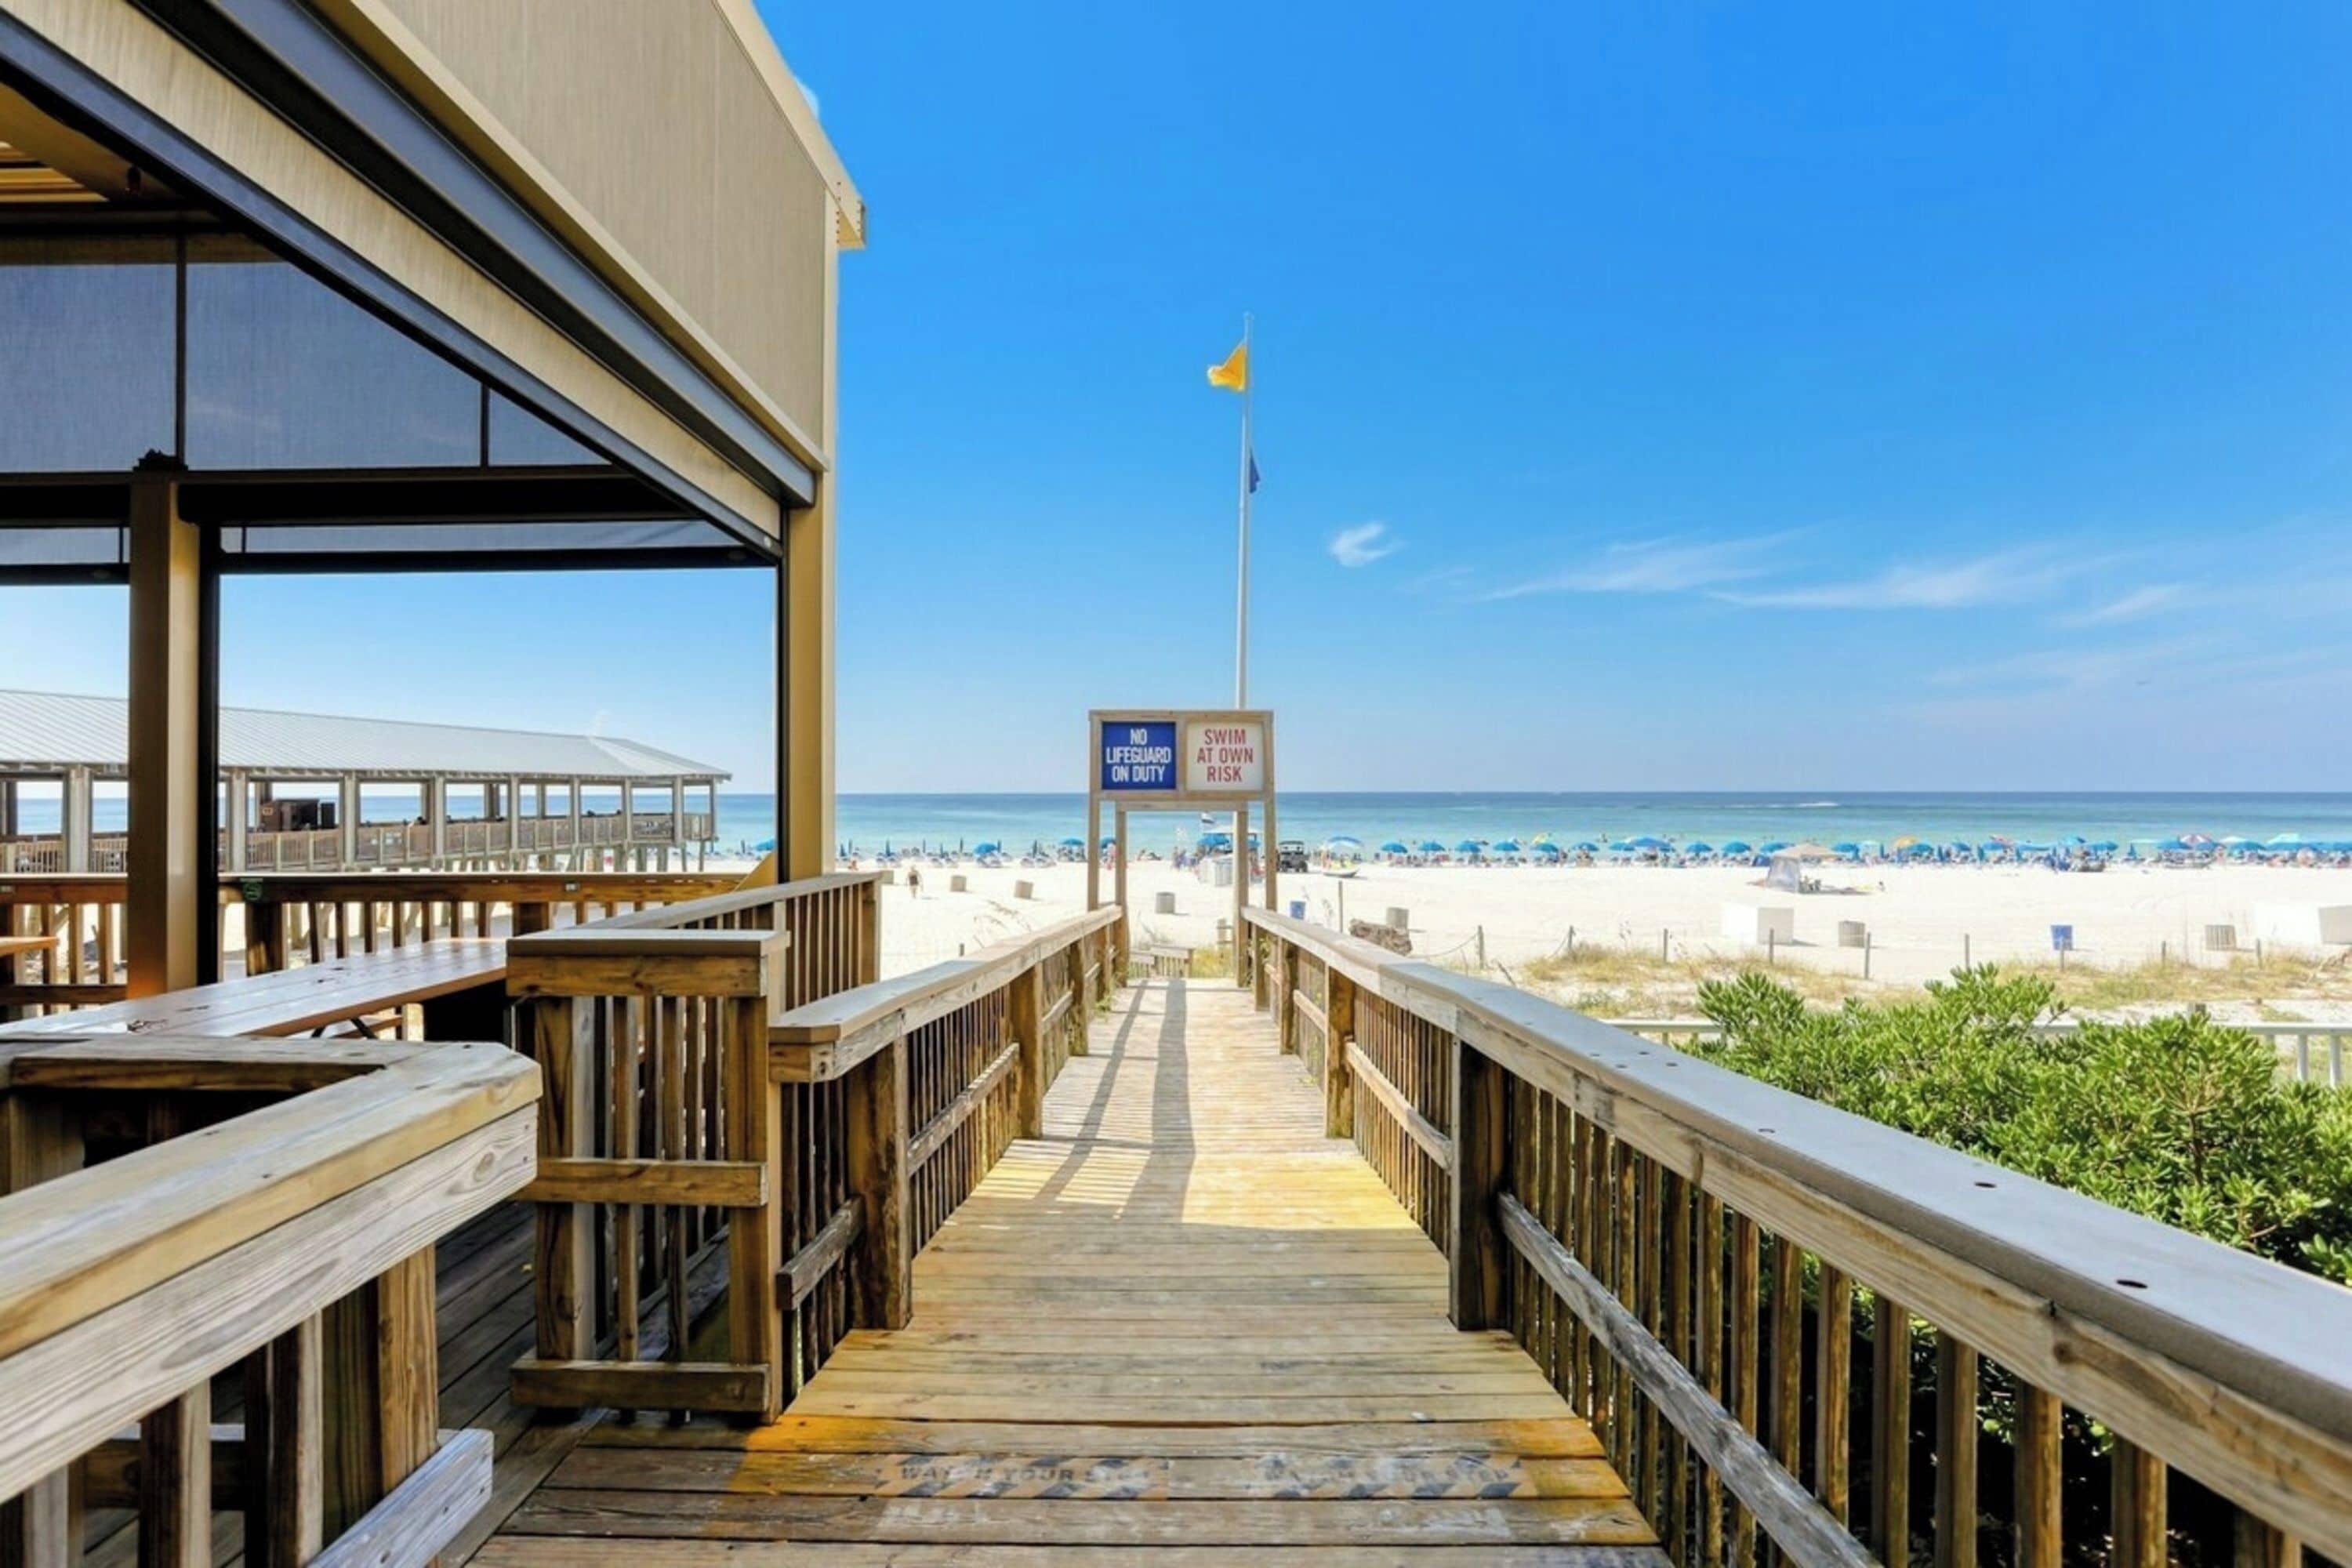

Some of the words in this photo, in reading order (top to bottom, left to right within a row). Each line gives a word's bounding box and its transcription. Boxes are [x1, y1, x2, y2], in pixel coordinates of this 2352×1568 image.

[1130, 728, 1148, 745] NO
[1204, 729, 1246, 746] SWIM
[1106, 747, 1171, 764] LIFEGUARD
[1196, 748, 1213, 764] AT
[1219, 748, 1254, 764] OWN
[1112, 765, 1129, 782] ON
[1133, 765, 1167, 782] DUTY
[1207, 766, 1243, 782] RISK
[1001, 1468, 1074, 1480] YOUR
